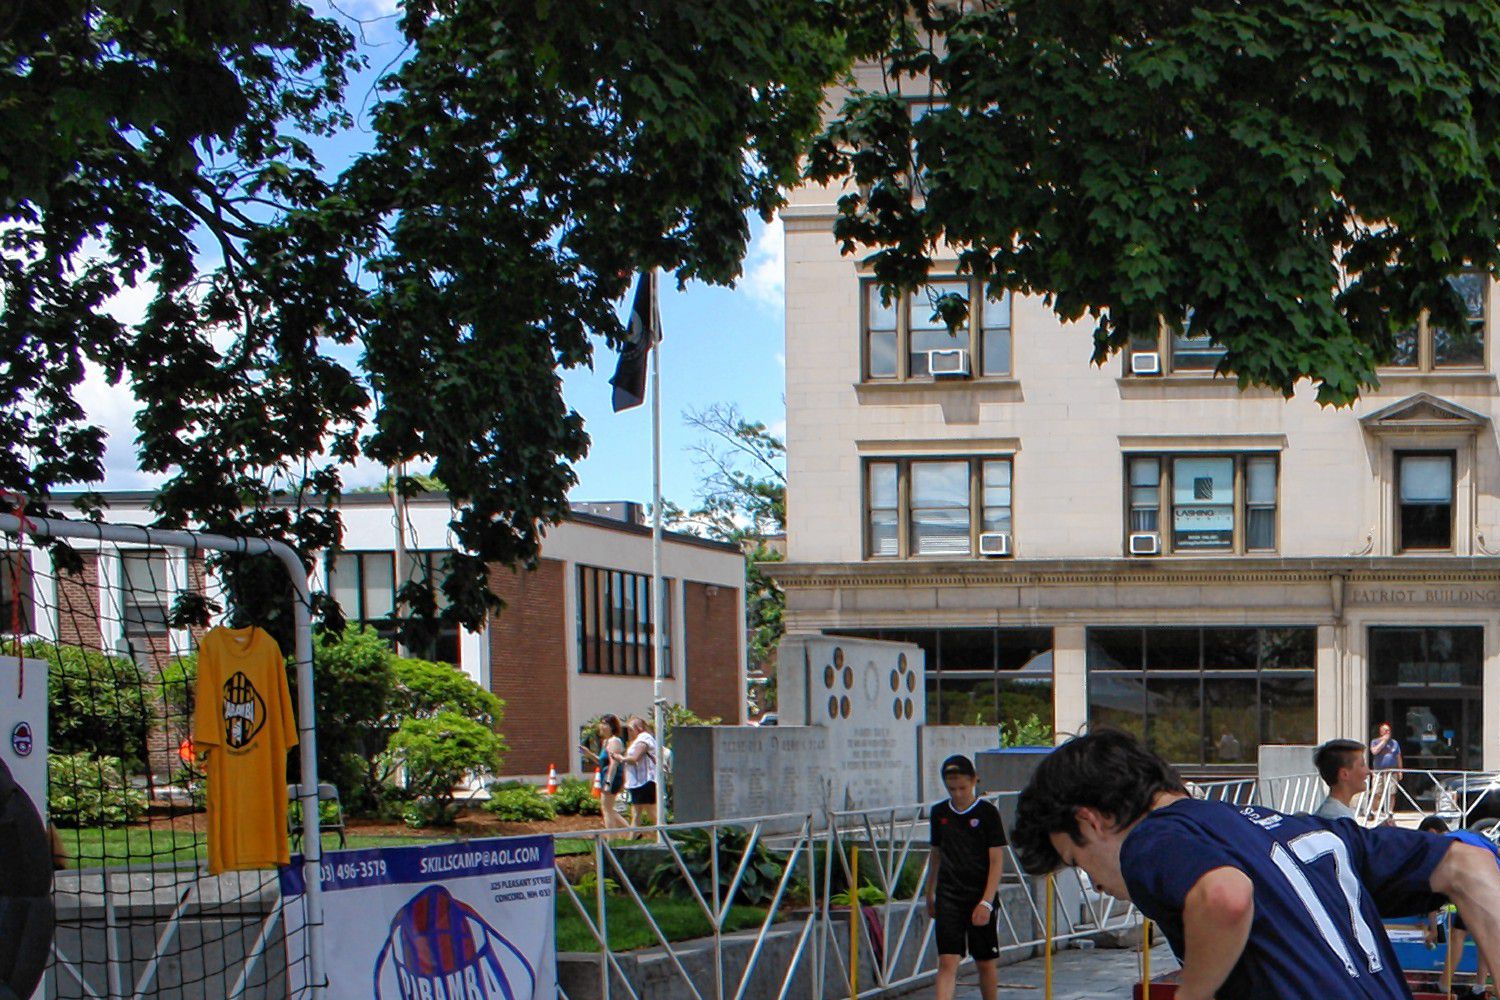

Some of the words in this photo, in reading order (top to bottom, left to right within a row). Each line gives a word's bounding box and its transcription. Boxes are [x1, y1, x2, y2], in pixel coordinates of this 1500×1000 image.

[1353, 590, 1416, 601] PATRIOT
[1426, 590, 1496, 601] BUILDING
[337, 858, 387, 880] 496-3579
[419, 846, 540, 874] SKILLSCAMP@AOL.COM
[502, 877, 532, 890] PLEASANT
[1270, 829, 1383, 978] 17
